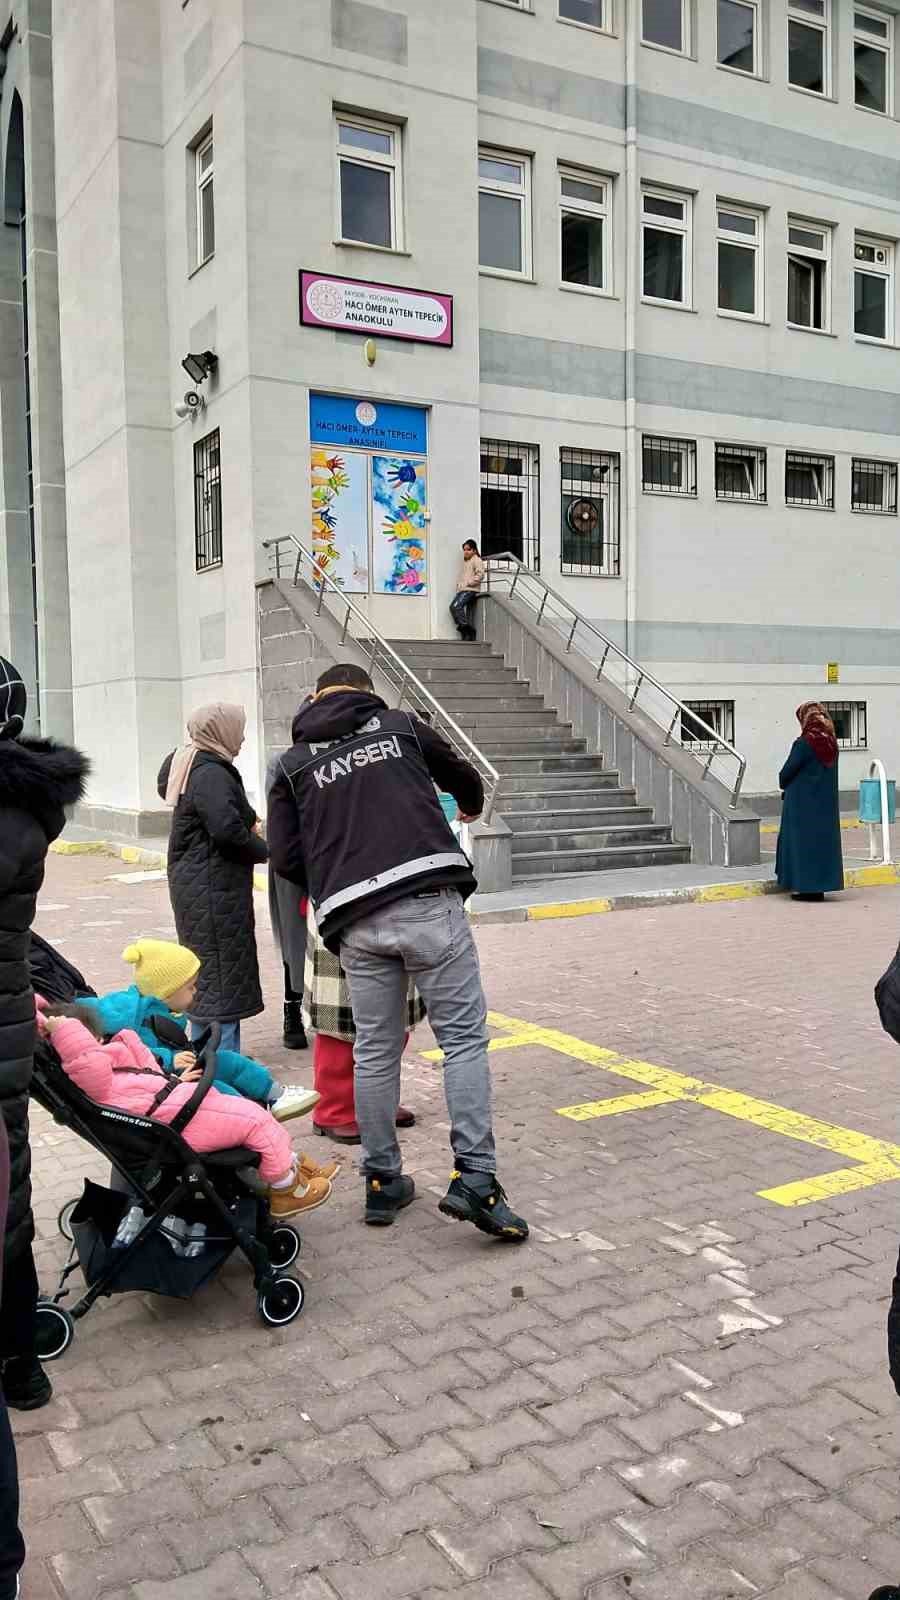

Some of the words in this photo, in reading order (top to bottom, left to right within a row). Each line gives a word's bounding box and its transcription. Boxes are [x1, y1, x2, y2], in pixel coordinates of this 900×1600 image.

[345, 299, 363, 310] HACI
[366, 302, 387, 314] ÖMER
[389, 305, 413, 318] AYTEN
[345, 312, 393, 327] ANAOKULU
